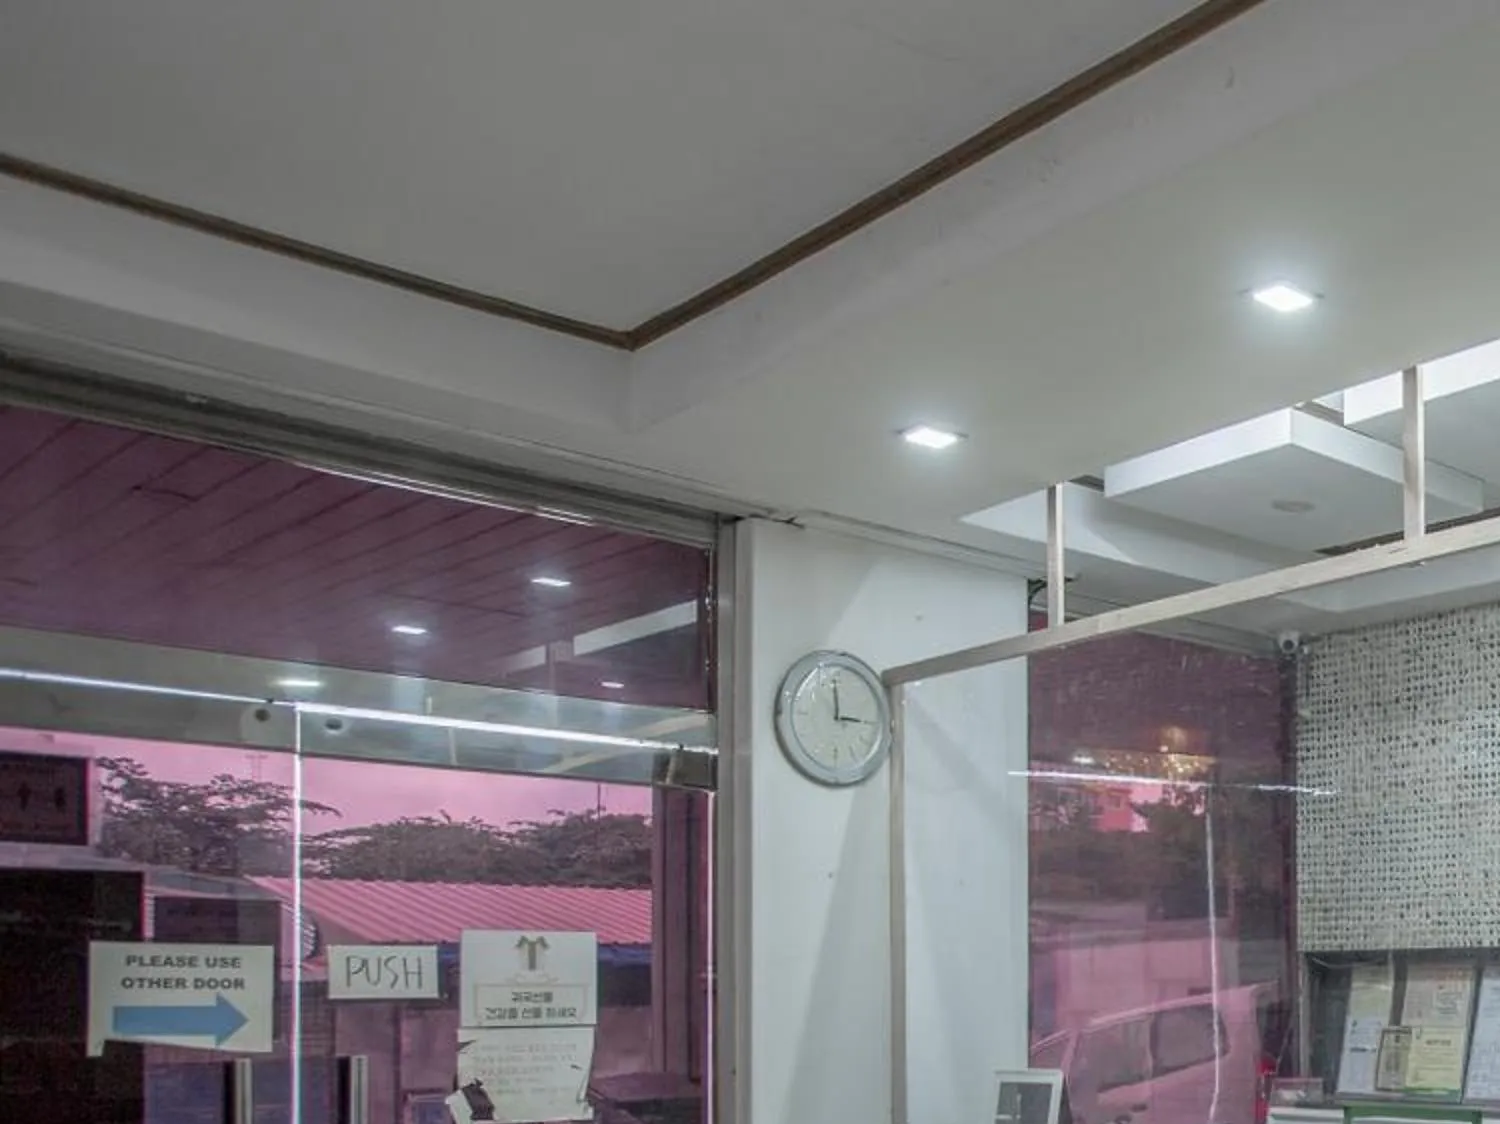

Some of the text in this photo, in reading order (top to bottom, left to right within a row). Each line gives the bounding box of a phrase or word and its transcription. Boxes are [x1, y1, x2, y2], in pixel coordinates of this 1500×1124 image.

[125, 954, 242, 969] PLEASE USE
[346, 955, 423, 990] PUSH
[121, 976, 245, 990] OTHER DOOR
